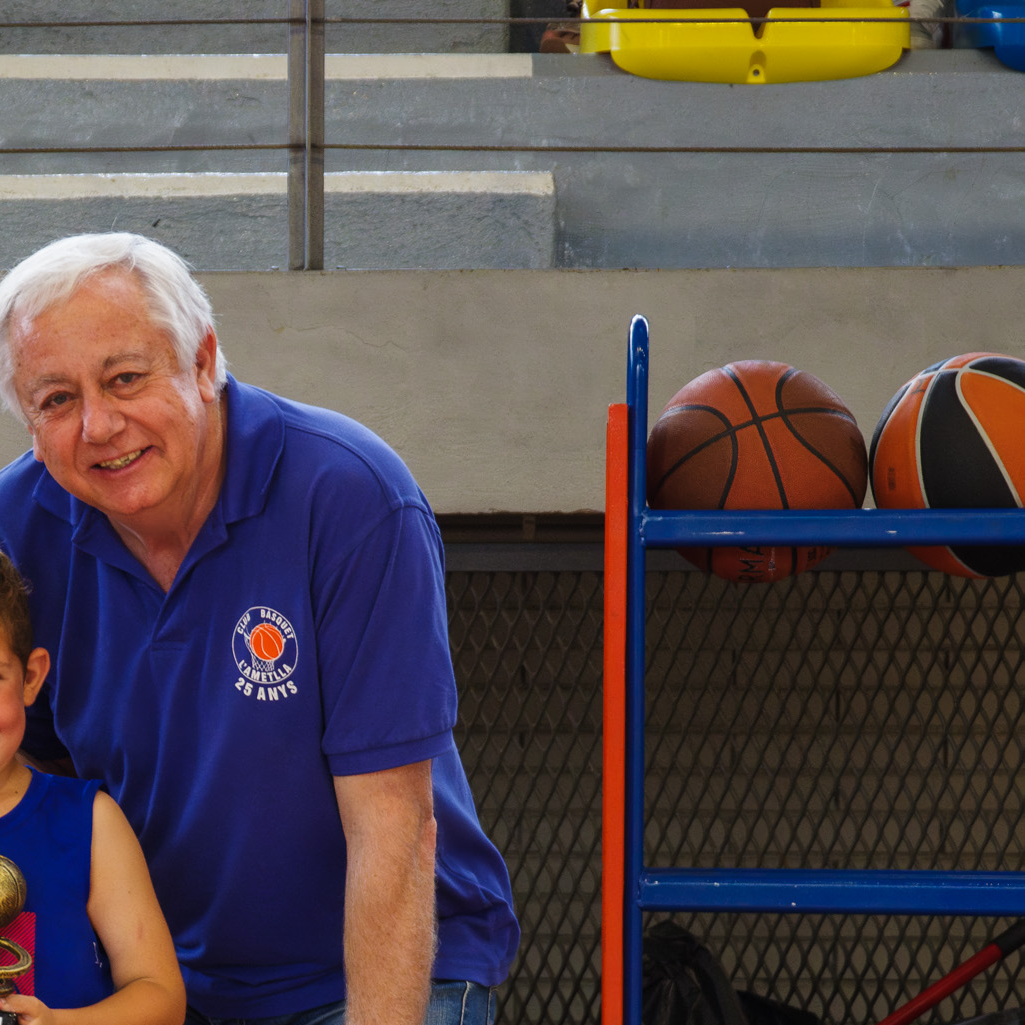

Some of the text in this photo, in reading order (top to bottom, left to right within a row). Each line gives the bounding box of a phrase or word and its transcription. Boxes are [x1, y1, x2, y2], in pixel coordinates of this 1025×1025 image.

[237, 608, 294, 639] CLUB BASQUET
[238, 659, 293, 682] L'AMETLLA
[235, 677, 298, 701] 25 ANYS
